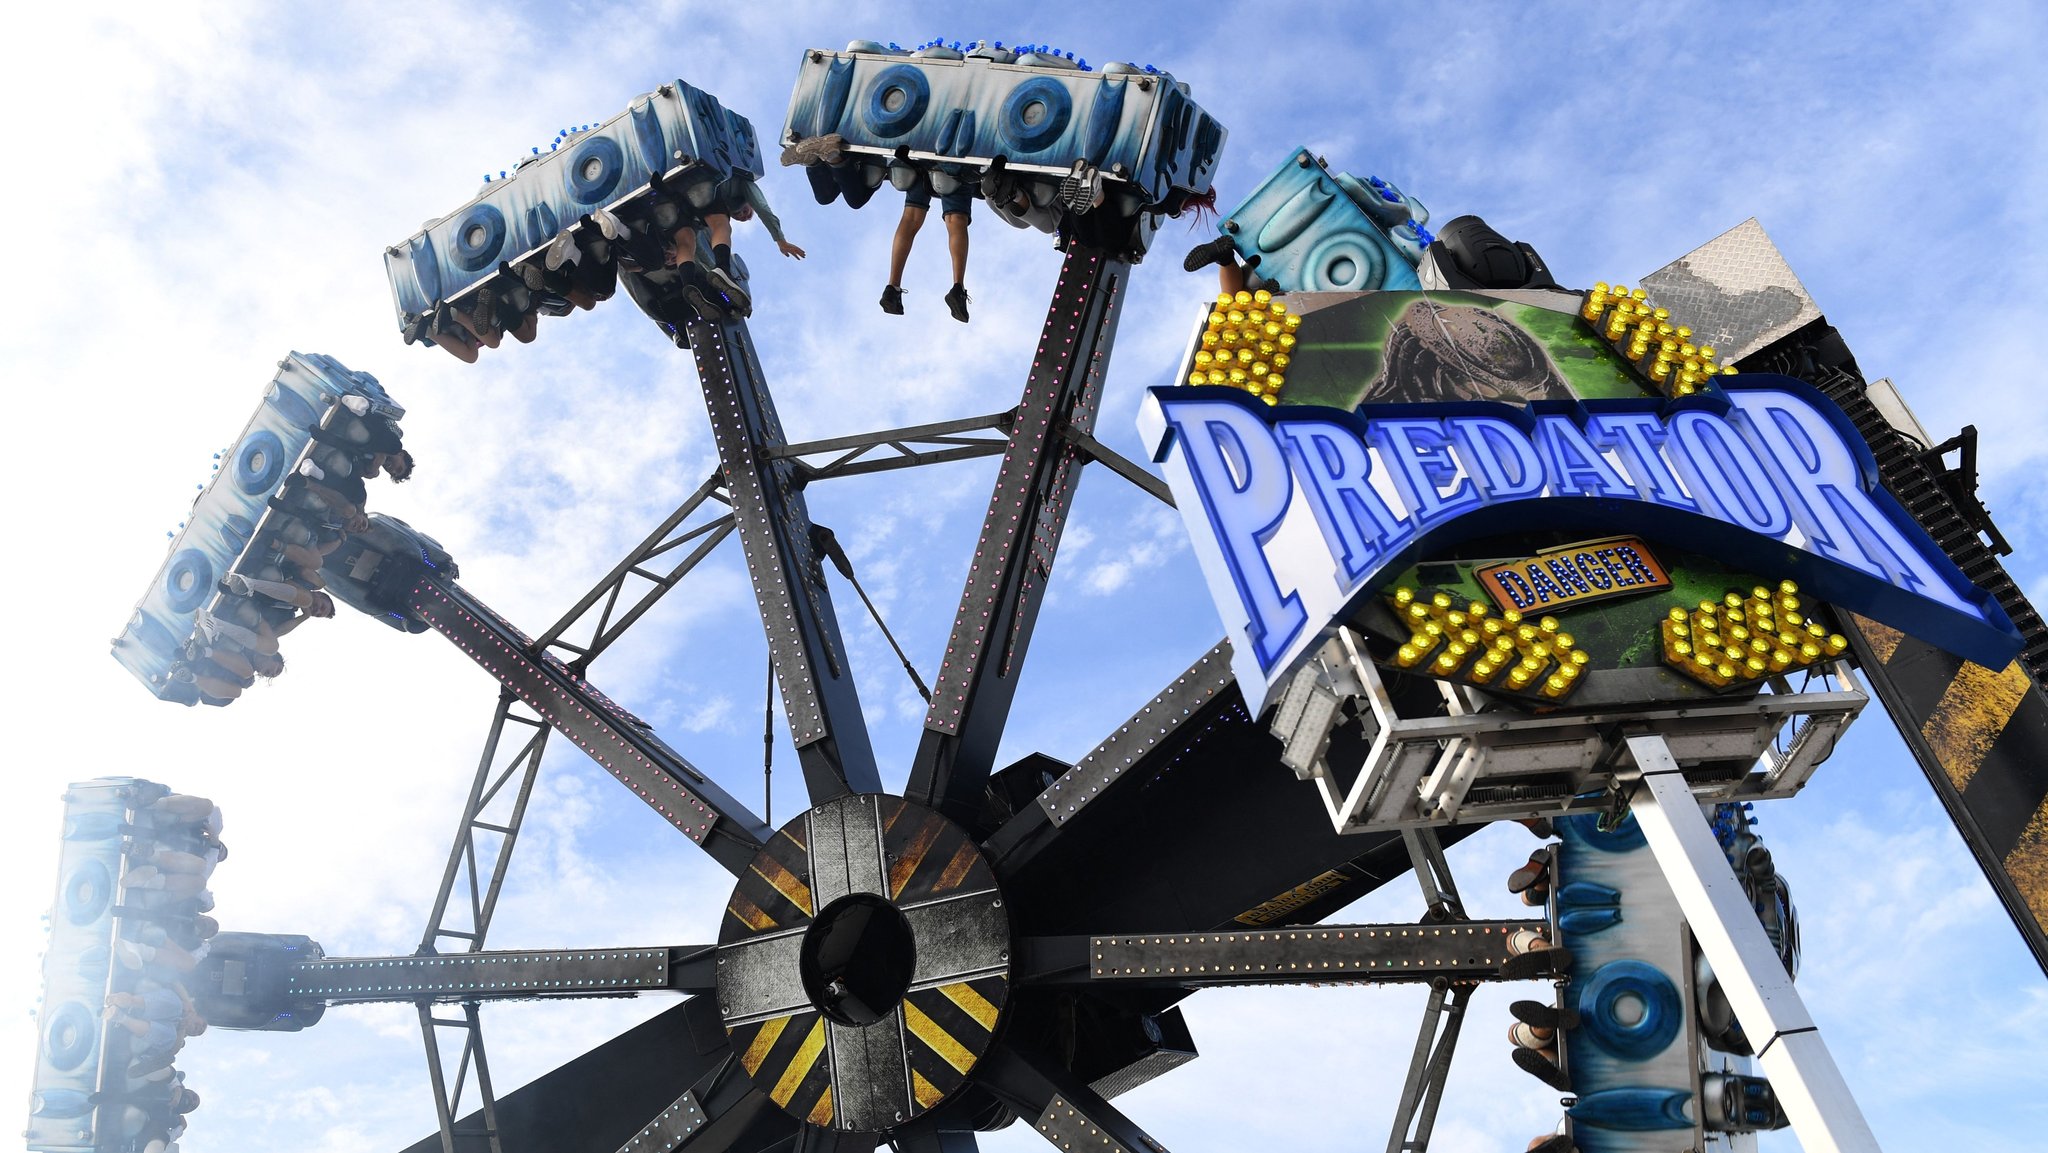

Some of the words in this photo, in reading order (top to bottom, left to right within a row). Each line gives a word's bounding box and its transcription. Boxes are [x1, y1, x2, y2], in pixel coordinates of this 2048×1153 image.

[1162, 389, 1992, 676] PREDATOR
[1493, 546, 1657, 609] DANGER
[1266, 884, 1333, 917] WARNING
[1303, 873, 1337, 893] HIGH
